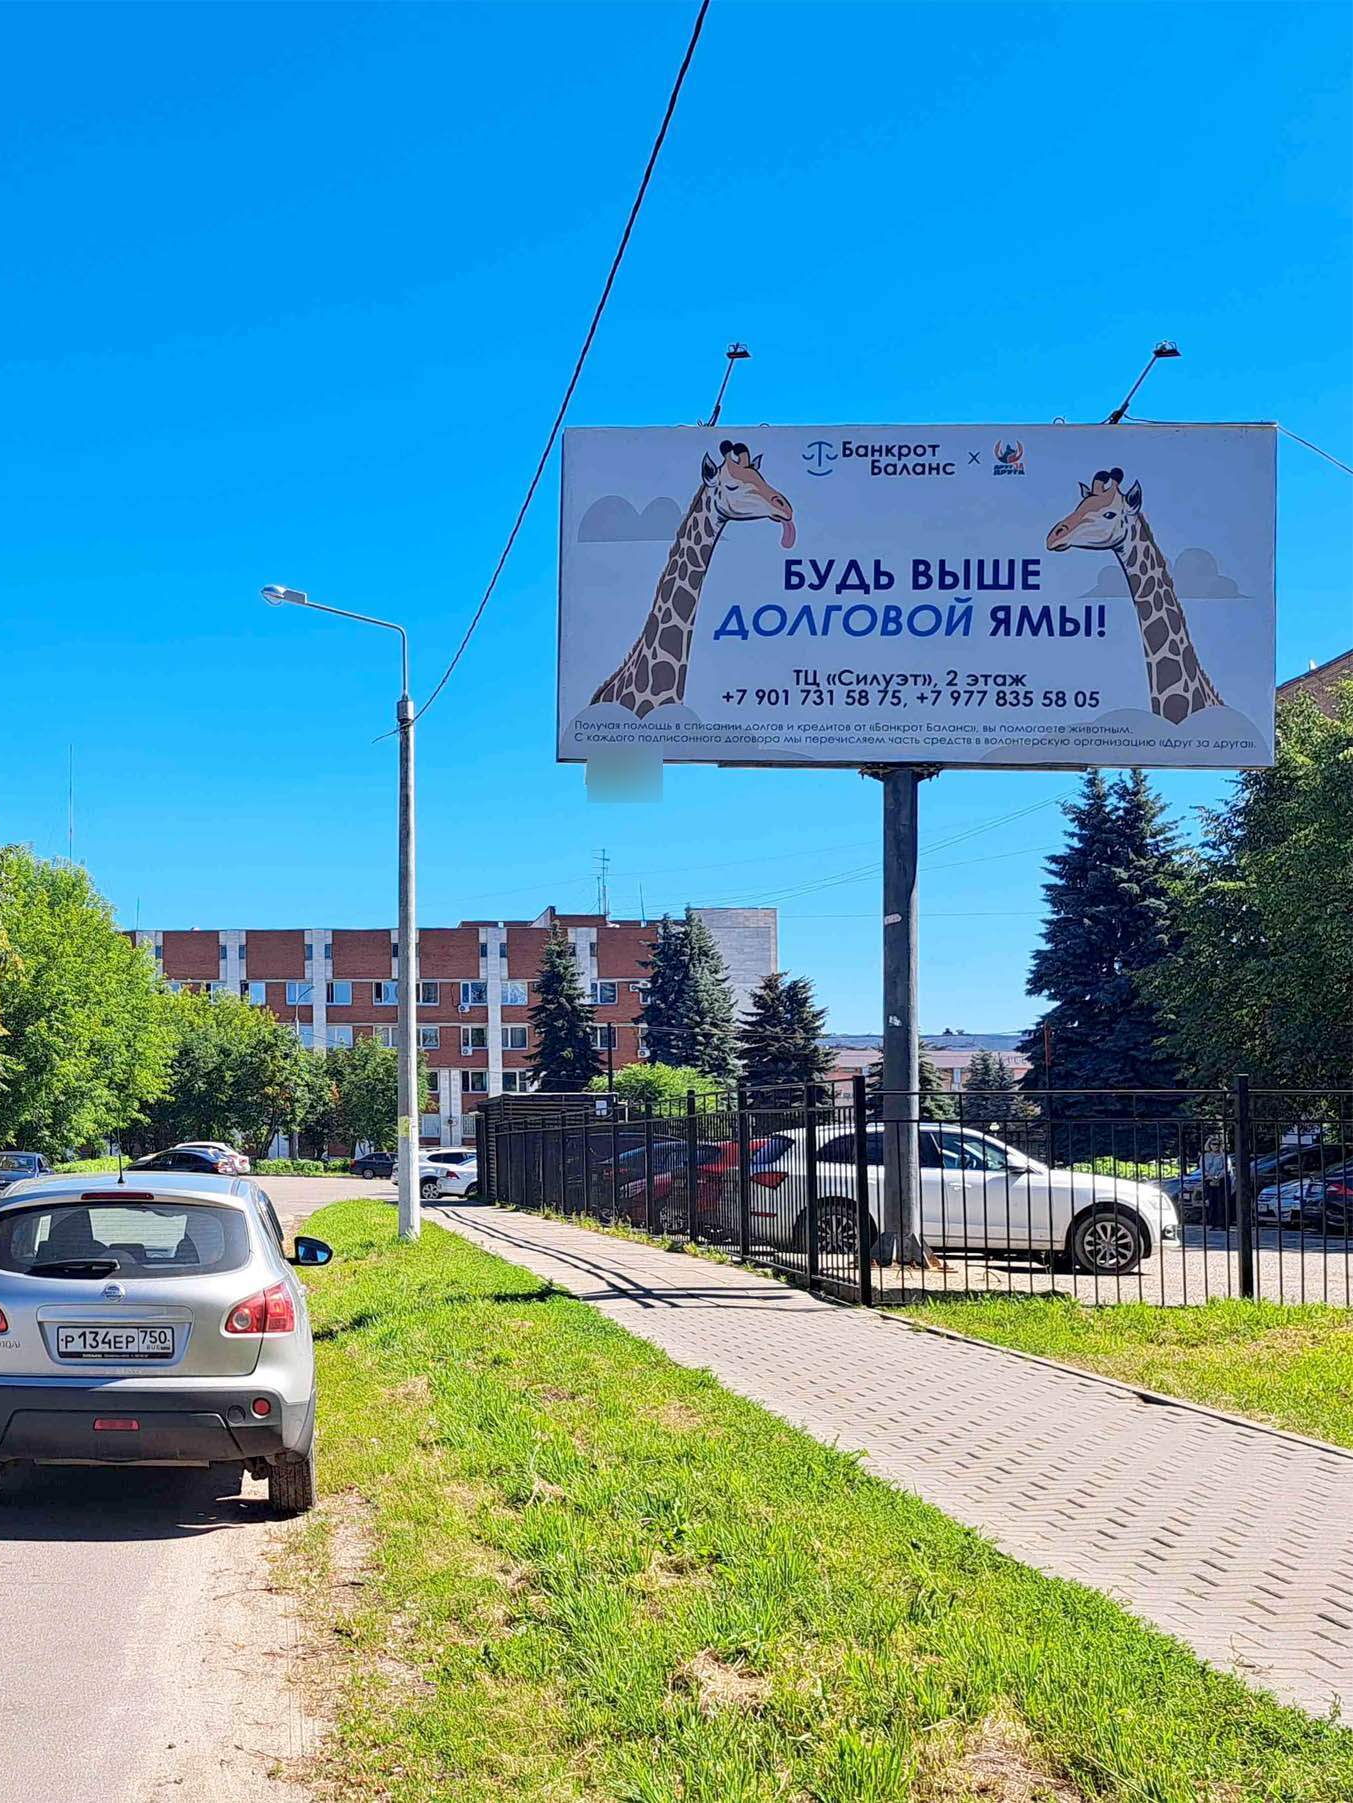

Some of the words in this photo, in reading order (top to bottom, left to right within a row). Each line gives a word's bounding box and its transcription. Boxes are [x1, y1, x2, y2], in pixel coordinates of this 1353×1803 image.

[841, 441, 940, 461] Банкрот
[870, 459, 955, 476] Баланс
[783, 558, 895, 595] БУДЬ
[911, 558, 1041, 591] ВЫШЕ
[713, 596, 973, 641] ДОЛГОВОЙ
[988, 604, 1106, 639] ЯМЫ!
[793, 670, 820, 690] ТЦ
[826, 670, 937, 692] «Силуэт»,
[945, 670, 959, 687] 2
[965, 673, 1027, 687] этаж
[721, 689, 748, 705] +7
[755, 689, 790, 706] 901
[800, 689, 834, 706] 731
[844, 690, 870, 706] 58
[877, 690, 908, 710] 75,
[916, 690, 942, 707] +7
[949, 690, 987, 708] 977
[994, 691, 1034, 708] 835
[1042, 691, 1067, 708] 58
[1074, 692, 1100, 708] 05
[574, 720, 621, 733] Получая
[623, 722, 672, 731] помощь
[684, 722, 742, 731] списании
[744, 723, 784, 732] долгов
[787, 723, 794, 731] и
[797, 723, 851, 733] кредитов
[854, 723, 866, 732] от
[983, 725, 996, 733] вы
[999, 725, 1066, 733] помогаете
[1069, 726, 1134, 734] животным.
[574, 732, 583, 742] С
[586, 734, 635, 743] каждого
[724, 734, 780, 745] договора
[783, 735, 802, 744] мы
[805, 735, 885, 745] перечисляем
[888, 735, 920, 745] часть
[923, 735, 972, 746] средств
[975, 736, 981, 745] в
[984, 737, 1070, 747] волонтерскую
[1073, 738, 1156, 748] организацию
[1196, 740, 1210, 748] за
[140, 1330, 168, 1344] 750
